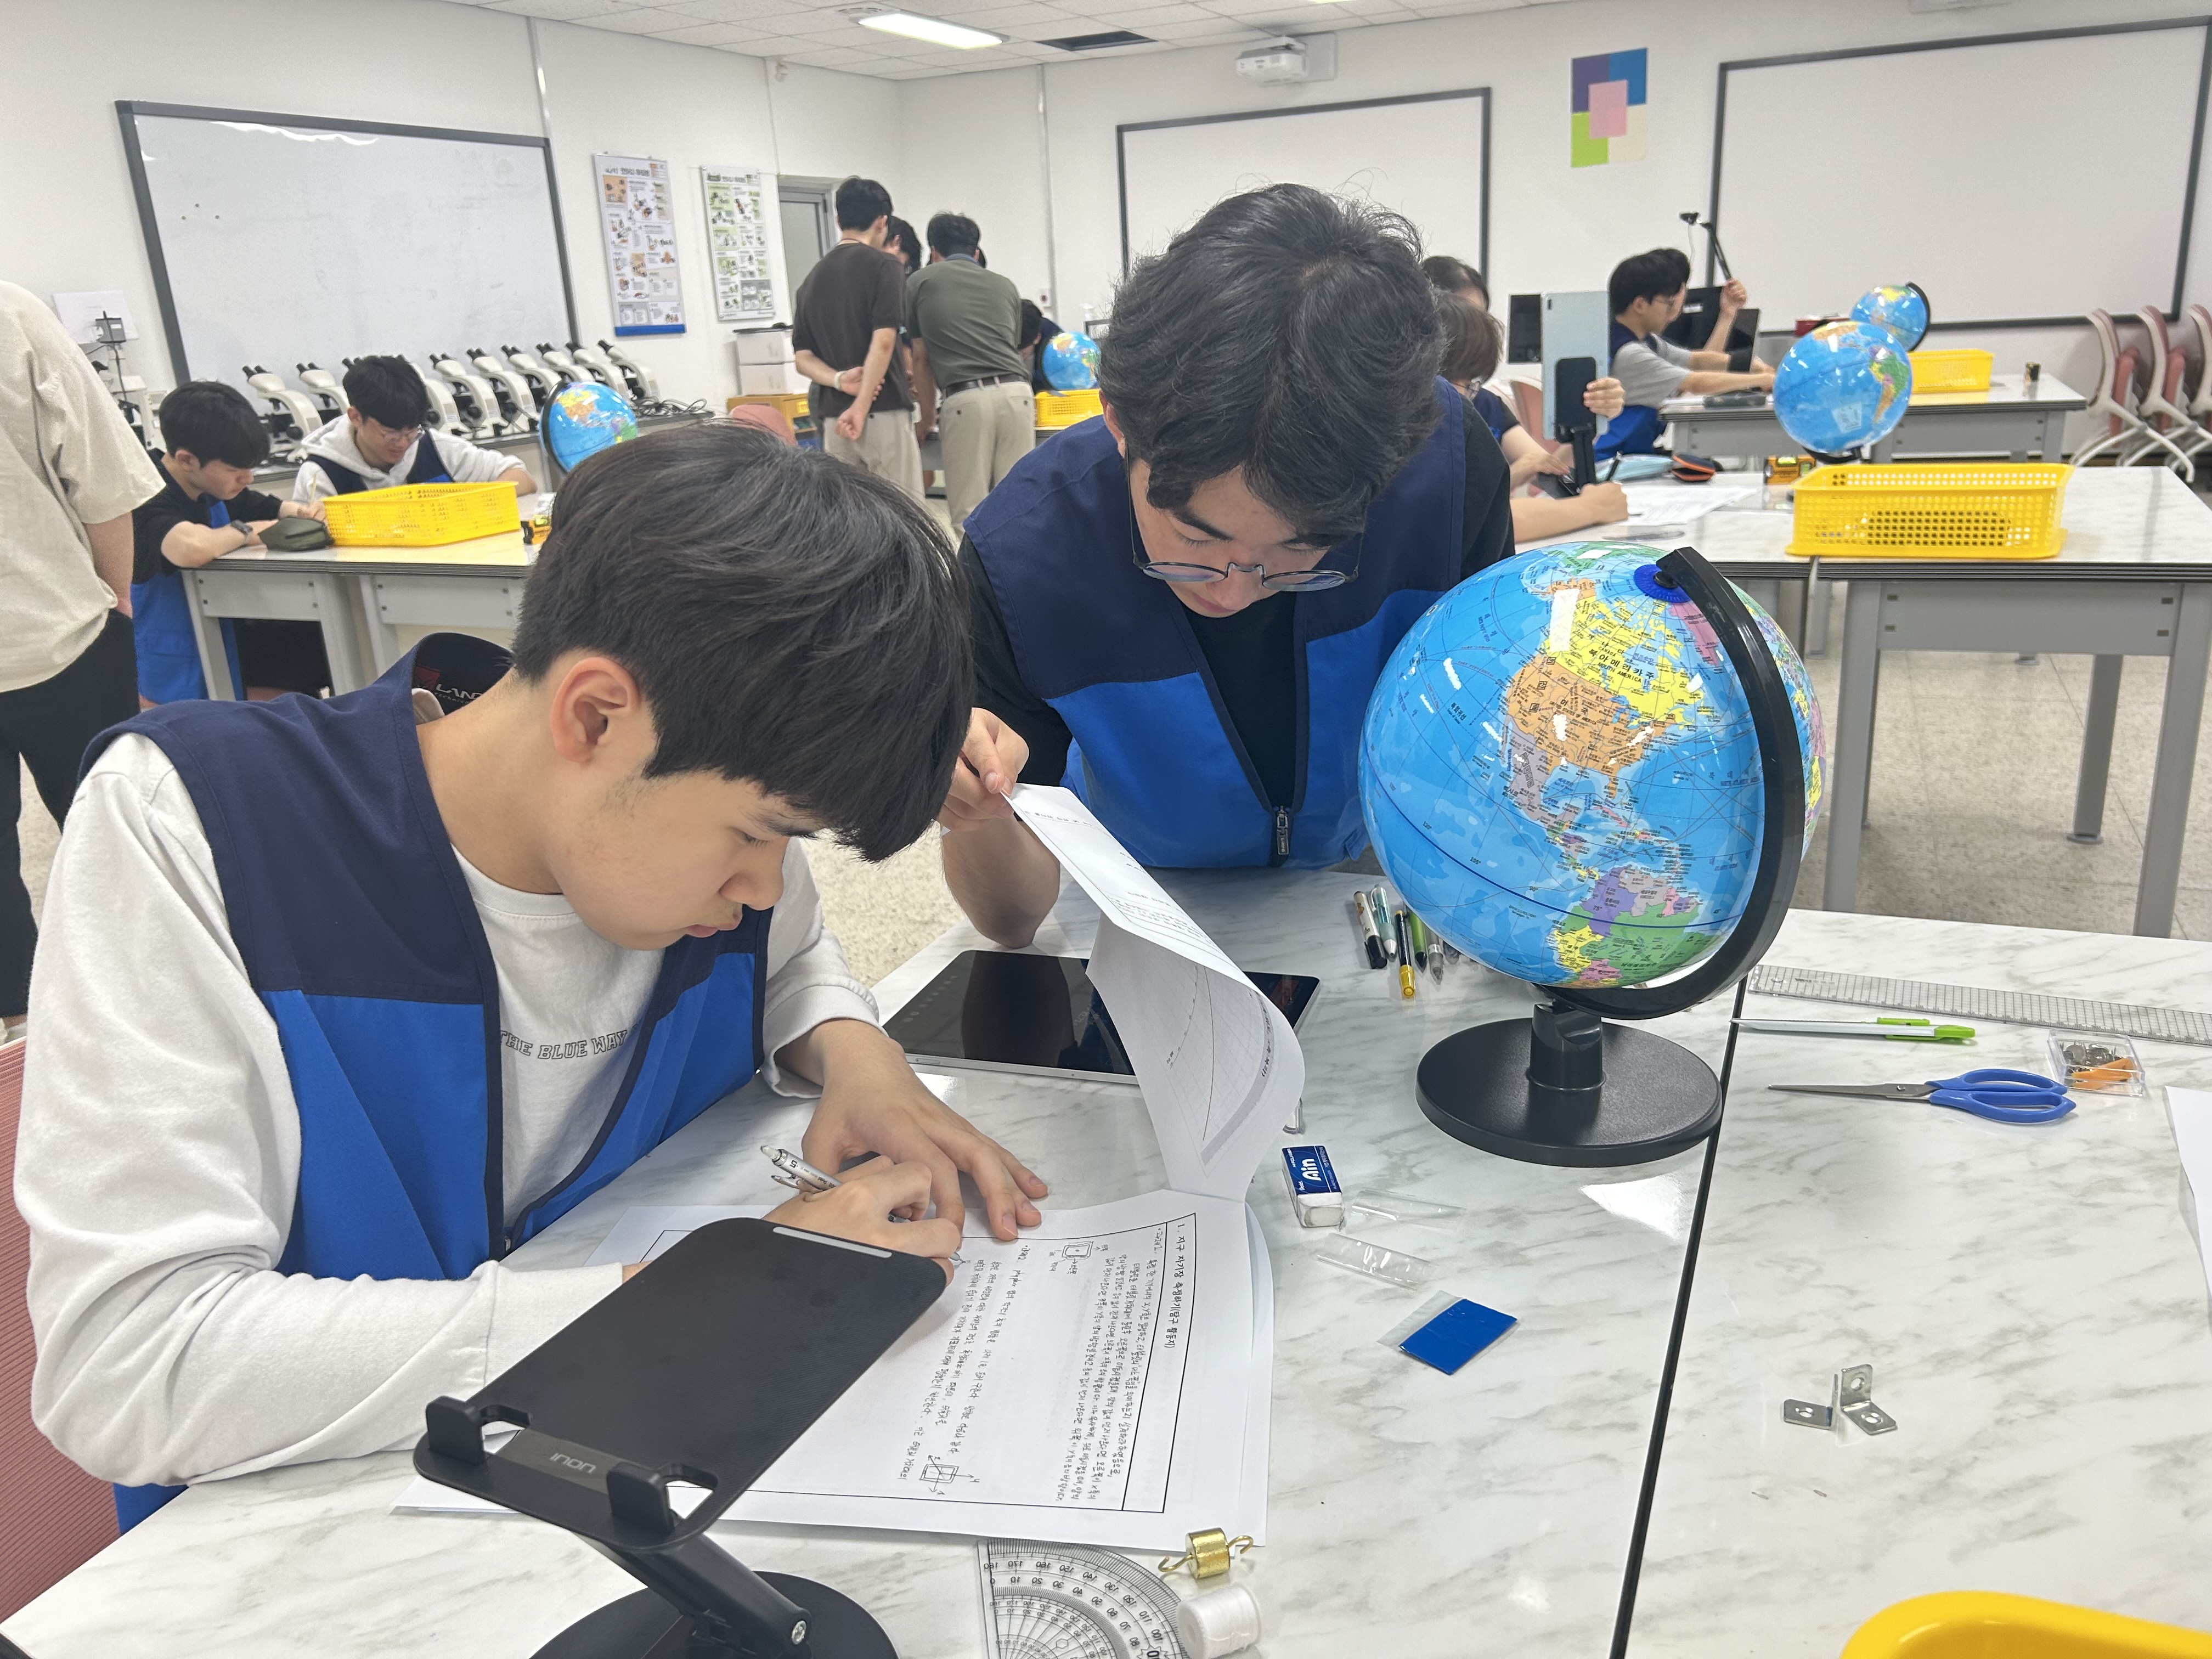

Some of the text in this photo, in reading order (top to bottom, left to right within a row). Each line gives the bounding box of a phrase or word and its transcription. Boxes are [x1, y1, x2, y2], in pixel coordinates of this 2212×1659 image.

[1617, 671, 1641, 682] AMERICA
[1470, 856, 1481, 865] 105°
[538, 1040, 588, 1060] BLUE
[591, 1030, 628, 1054] WAY
[1301, 1159, 1322, 1181] Ain
[1175, 1236, 1185, 1251] 지구
[1174, 1255, 1184, 1278] 자기장
[1169, 1282, 1183, 1324] 측정하기(탐구
[1164, 1327, 1177, 1348] 활동지)
